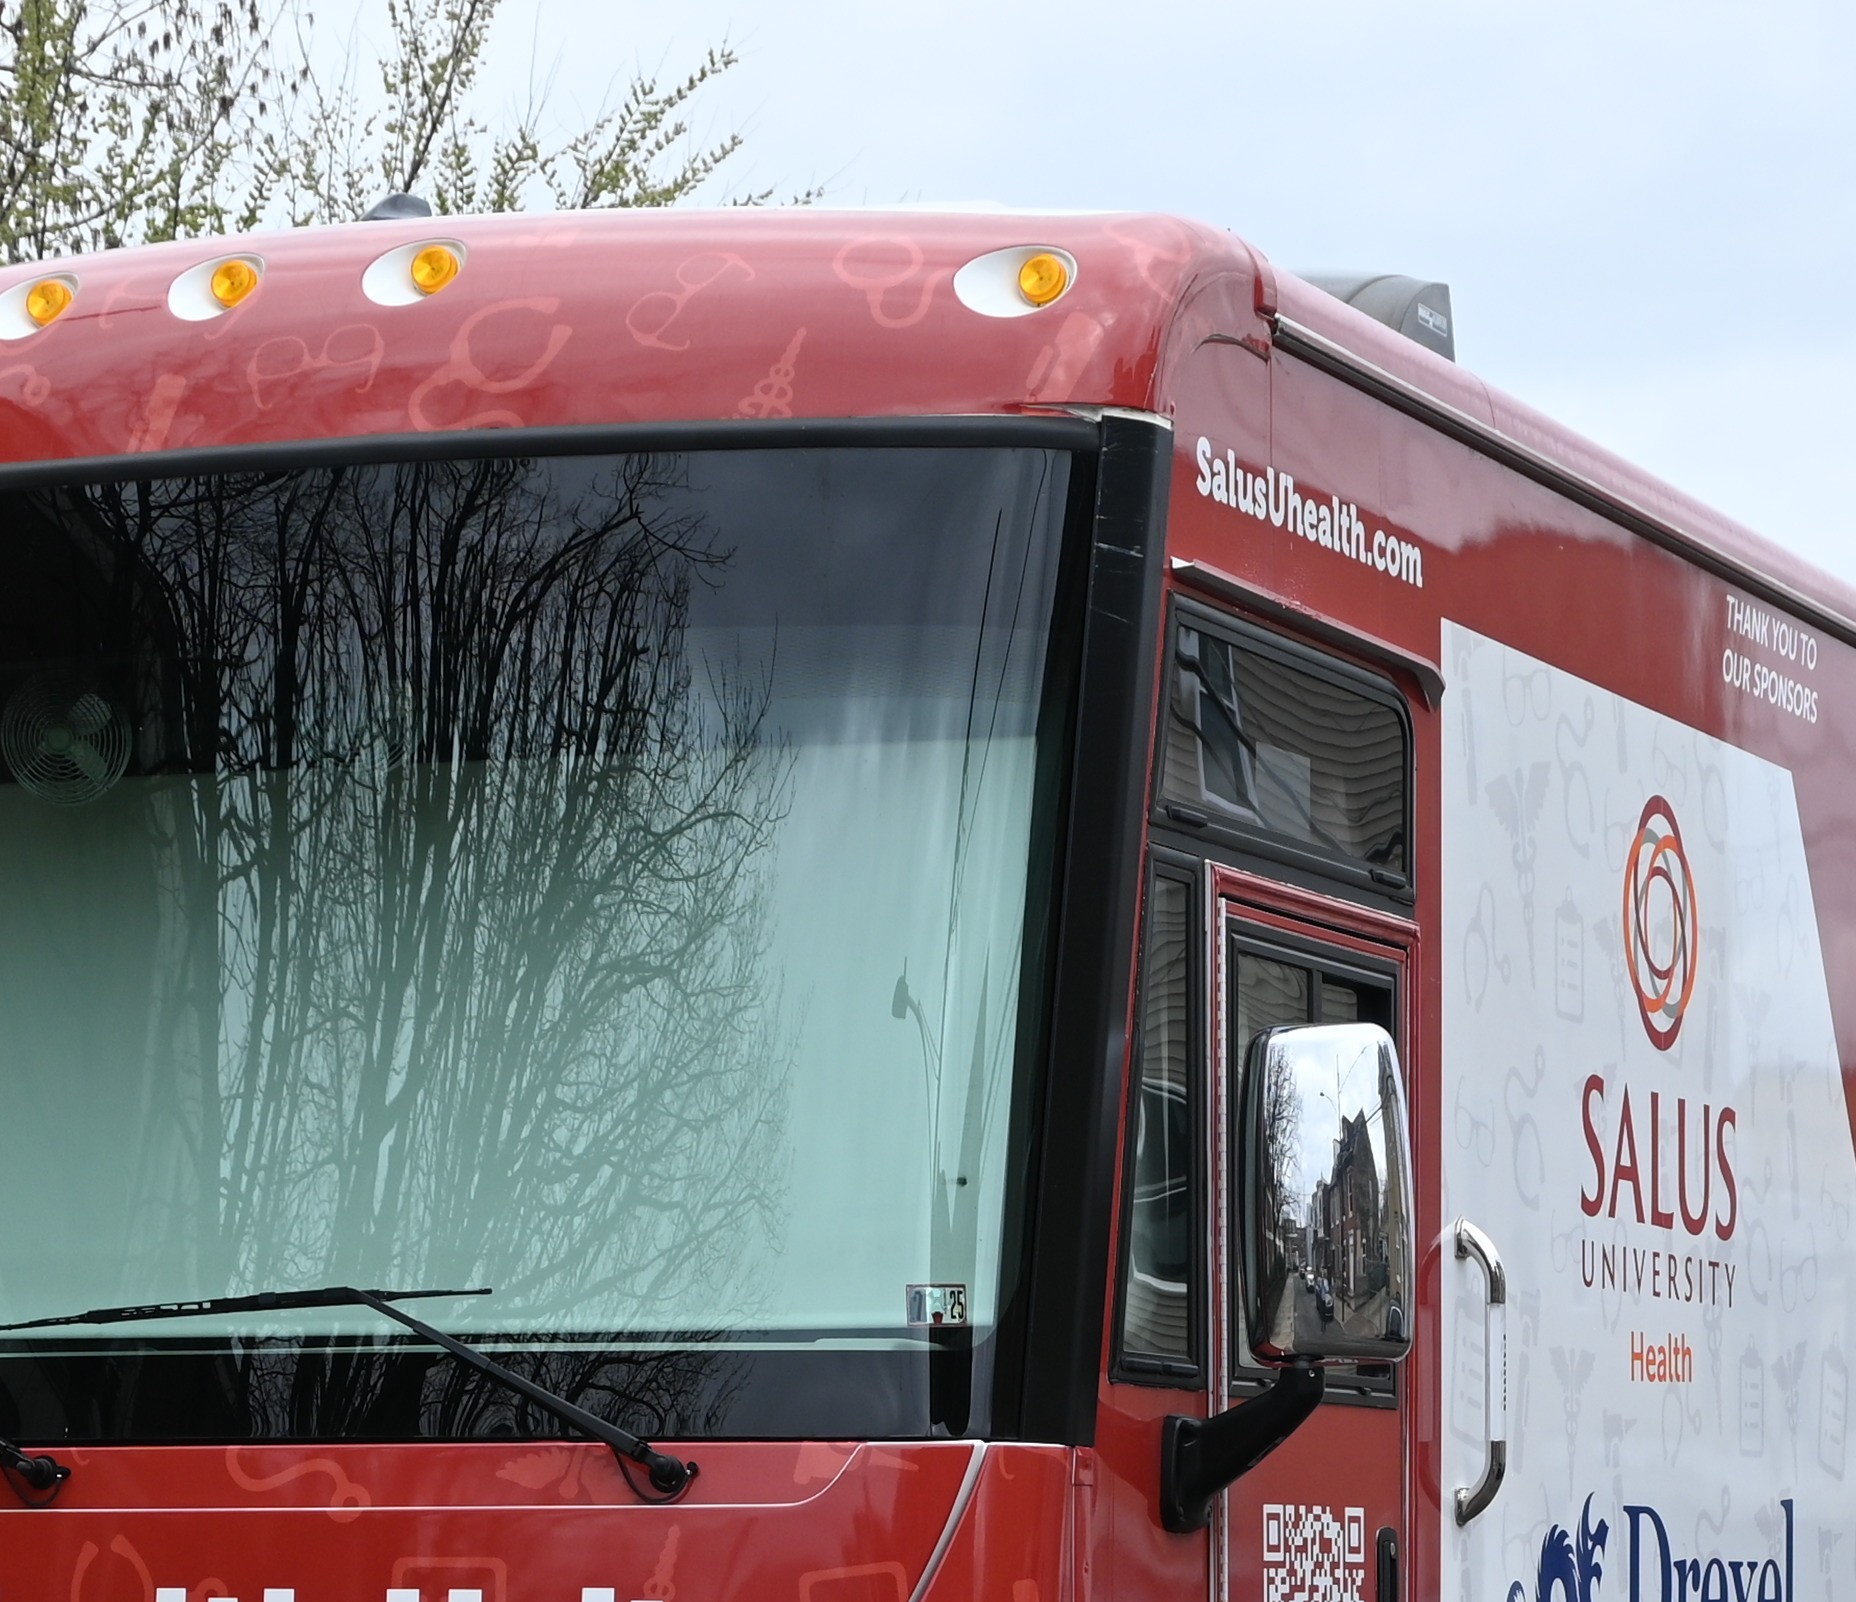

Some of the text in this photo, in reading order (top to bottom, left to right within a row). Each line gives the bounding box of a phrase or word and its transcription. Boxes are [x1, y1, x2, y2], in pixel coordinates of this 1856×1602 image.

[1196, 436, 1423, 588] SalusUhealth.com
[1726, 594, 1817, 670] THANK YOU TO
[1722, 648, 1818, 724] OUR SPONSORS
[1581, 1074, 1737, 1241] SALUS
[949, 1290, 963, 1320] 25
[1582, 1239, 1736, 1308] UNIVERSITY
[1631, 1331, 1692, 1383] Health
